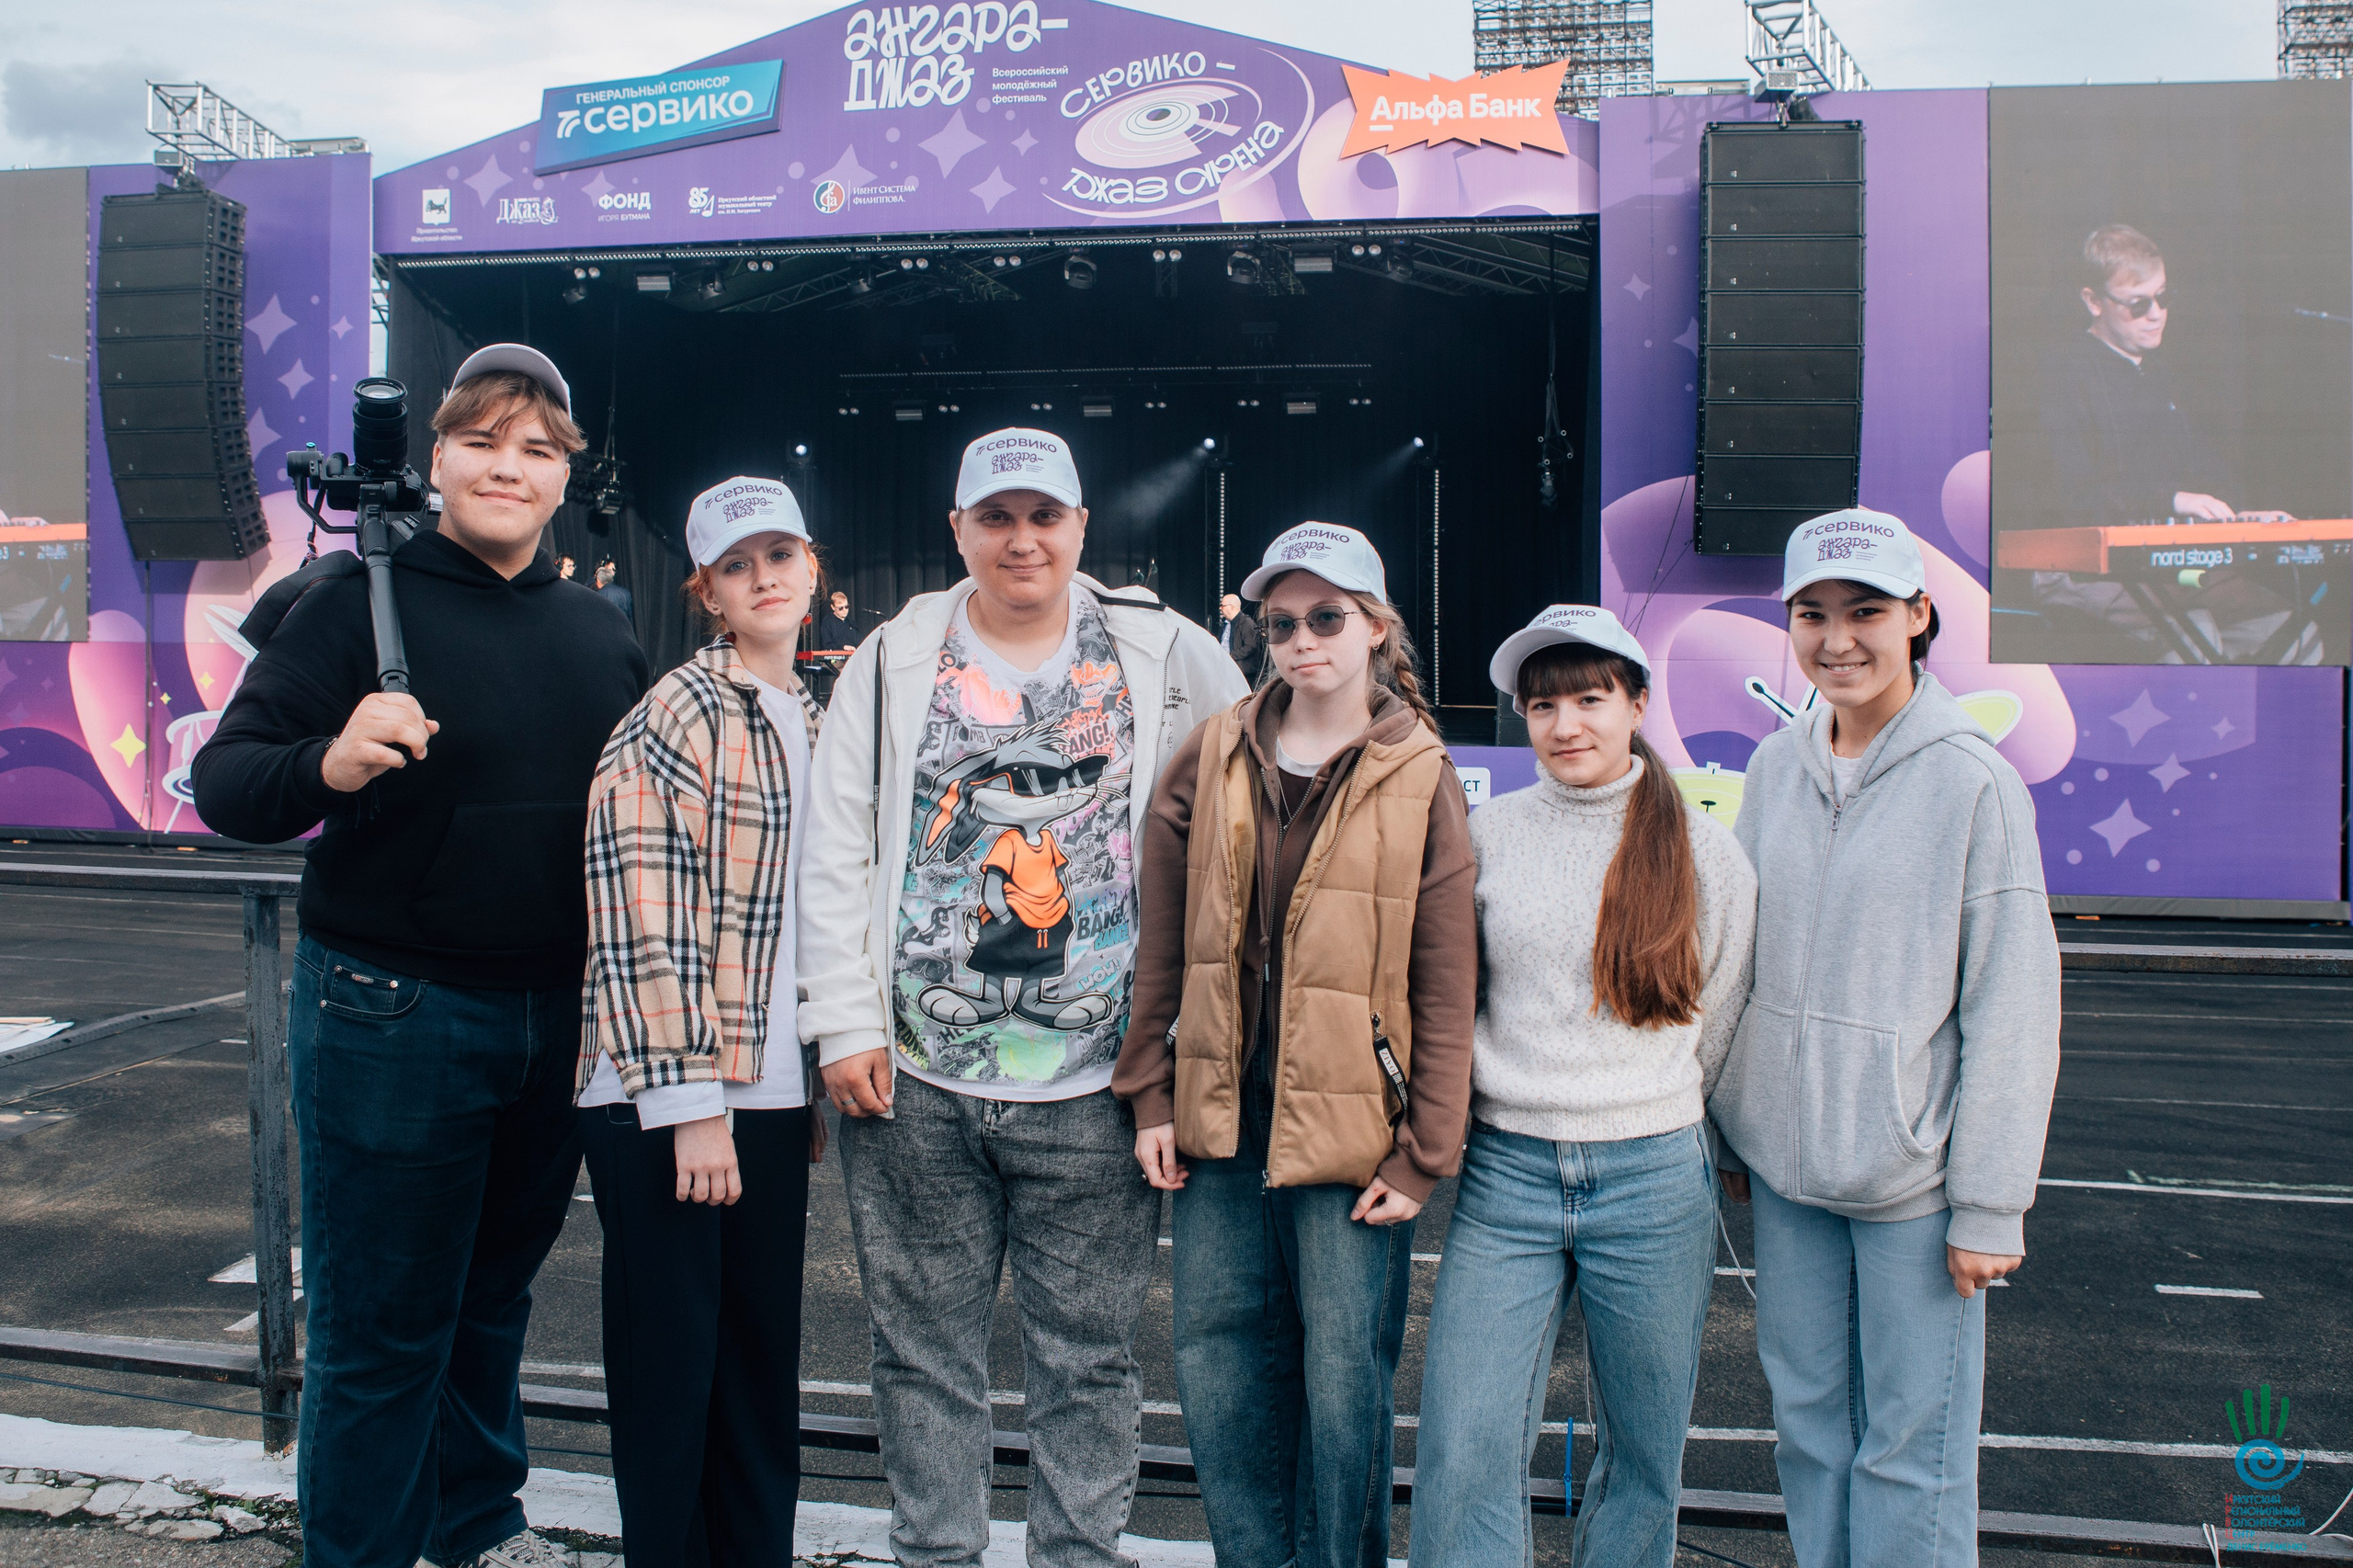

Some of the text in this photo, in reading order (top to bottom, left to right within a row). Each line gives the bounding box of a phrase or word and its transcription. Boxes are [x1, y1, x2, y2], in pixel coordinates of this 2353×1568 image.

[993, 65, 1069, 78] Всероссийский
[575, 75, 731, 105] ГЕНЕРАЛЬНЫЙ СПОНСОР
[992, 79, 1058, 91] молодёжный
[1060, 51, 1207, 119] СЕРВИКО
[992, 94, 1047, 105] фестиваль
[1369, 93, 1542, 131] Альфа Банк
[688, 187, 710, 209] 85
[879, 185, 916, 194] СИСТЕМА
[598, 192, 652, 210] ФОНД
[2151, 546, 2234, 568] nord stage 3
[1079, 957, 1122, 990] WOW!
